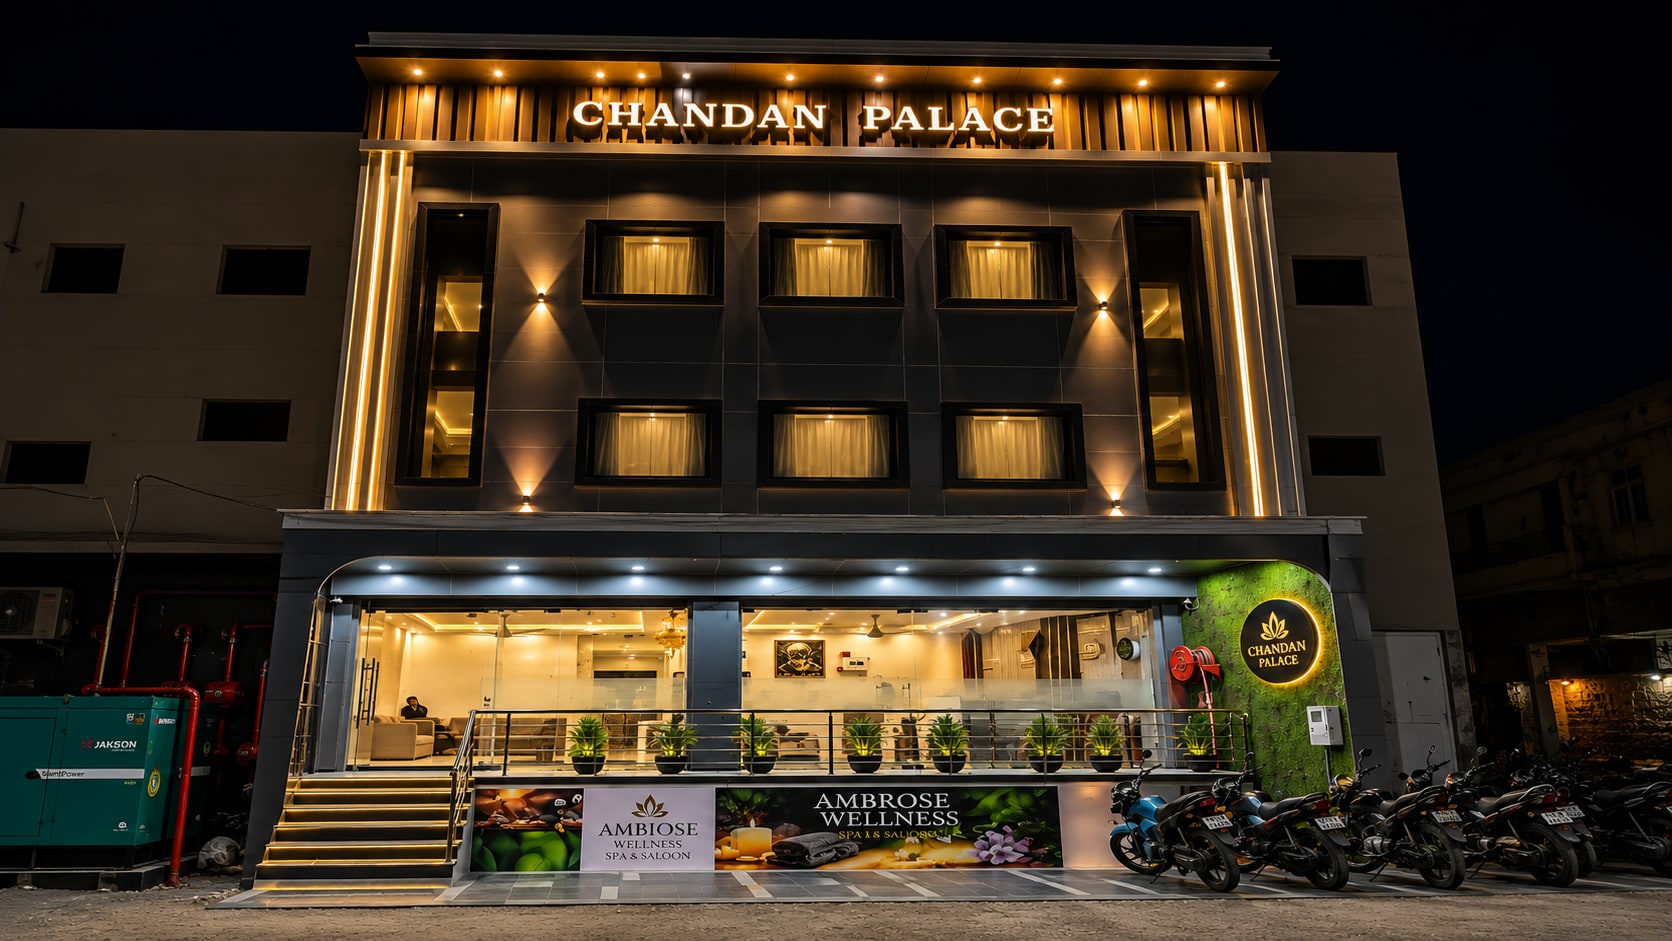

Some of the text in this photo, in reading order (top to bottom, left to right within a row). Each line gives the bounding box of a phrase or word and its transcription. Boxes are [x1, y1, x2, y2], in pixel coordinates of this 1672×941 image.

[573, 101, 1055, 133] CHANDAN PALACE
[1248, 640, 1306, 656] CHANDAN
[1259, 655, 1299, 668] PALACE
[94, 740, 137, 749] JAKSON
[813, 793, 950, 809] AMBROSE
[820, 811, 959, 827] WELLNESS
[599, 822, 698, 836] AMBIOSE
[838, 831, 862, 839] SPA
[614, 840, 682, 849] WELLNESS
[605, 852, 691, 861] SPA & SALOON
